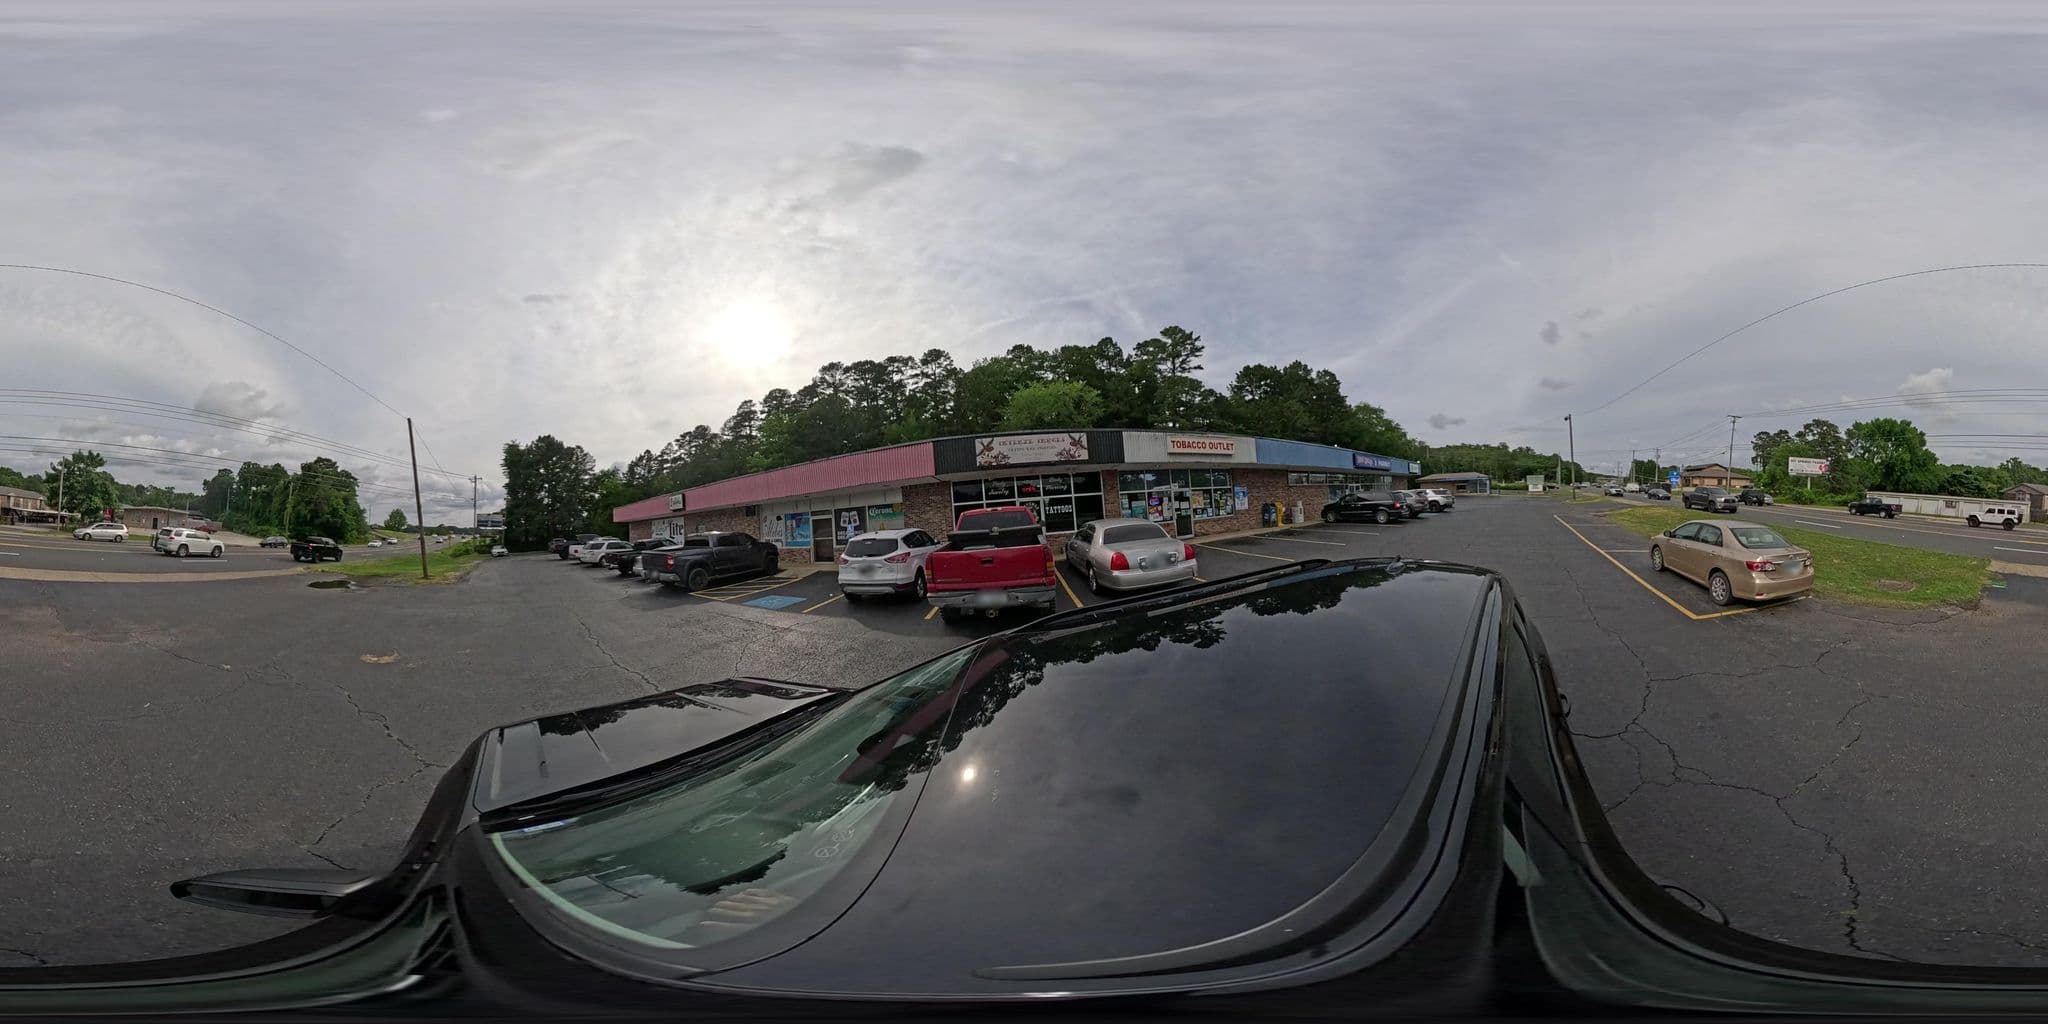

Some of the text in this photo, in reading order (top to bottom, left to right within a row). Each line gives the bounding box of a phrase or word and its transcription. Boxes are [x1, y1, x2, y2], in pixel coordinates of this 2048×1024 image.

[1170, 440, 1234, 451] TOBACCO OUTLET
[869, 507, 893, 516] Corona
[1045, 504, 1073, 514] TATTOOS
[669, 522, 684, 540] Lite
